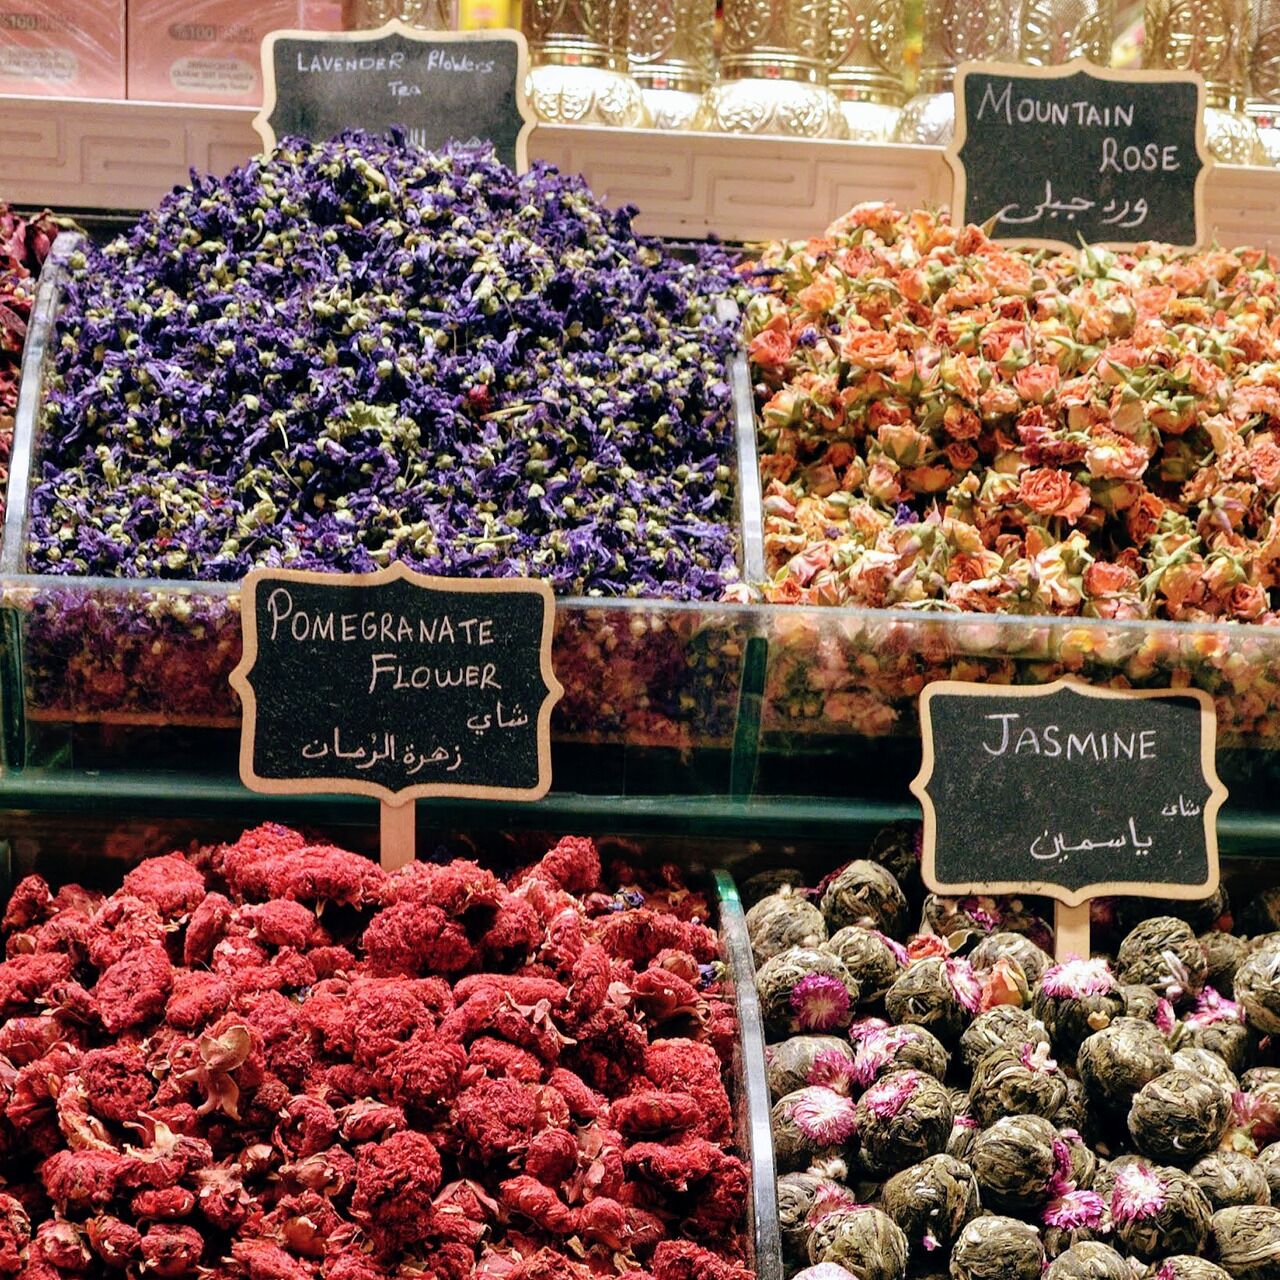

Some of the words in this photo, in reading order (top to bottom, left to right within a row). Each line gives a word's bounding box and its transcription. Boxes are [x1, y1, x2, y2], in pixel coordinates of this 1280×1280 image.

[297, 52, 404, 72] LAVENDER
[388, 81, 421, 97] Tea
[977, 82, 1134, 127] MOUNTAIN
[1099, 143, 1179, 173] ROSE
[268, 588, 494, 646] POMEGRANATE
[369, 653, 502, 694] FLOWER
[983, 713, 1157, 761] JASMINE
[1030, 816, 1153, 864] ياسمين
